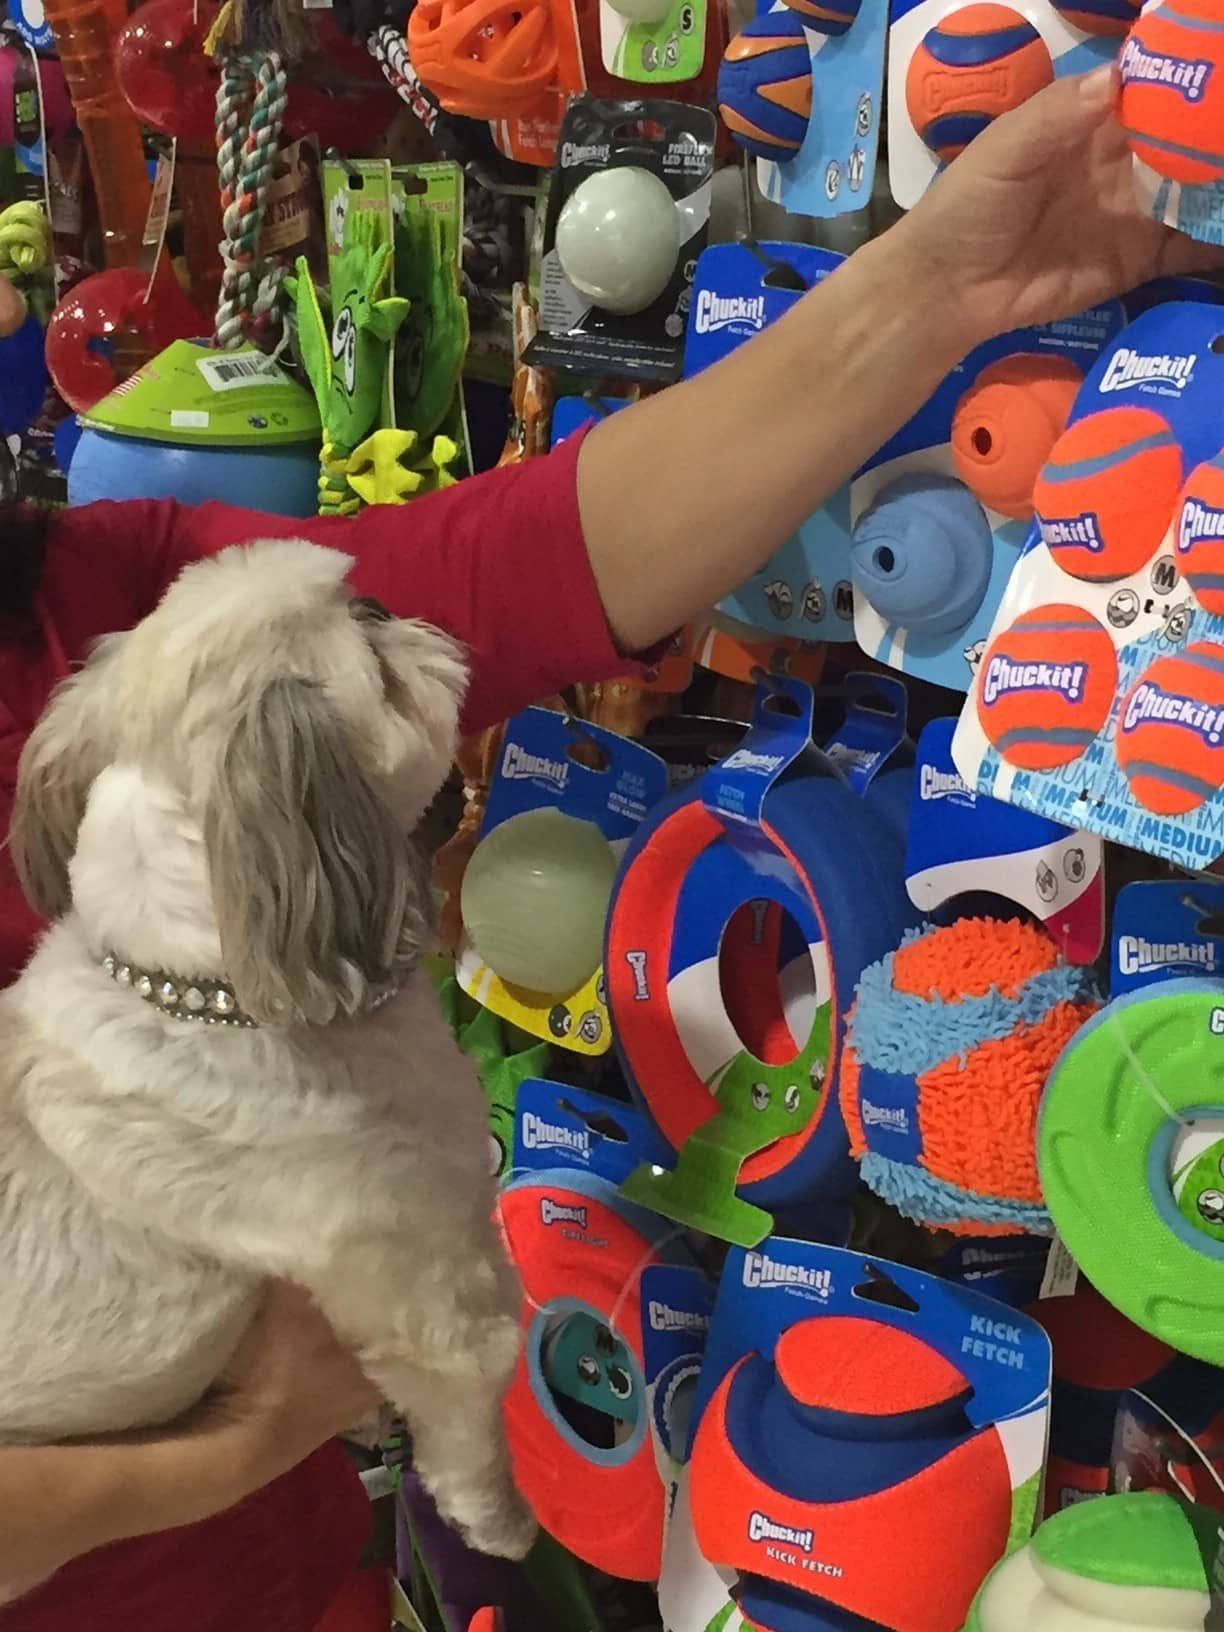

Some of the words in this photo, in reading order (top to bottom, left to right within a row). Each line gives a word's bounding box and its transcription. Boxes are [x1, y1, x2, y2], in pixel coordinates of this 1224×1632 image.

[1119, 40, 1207, 98] Chuckit!
[561, 142, 611, 168] Chuckit!
[684, 155, 707, 168] BALL
[696, 290, 764, 333] Chuckit!
[1099, 348, 1197, 393] Chuckit!
[1155, 562, 1176, 588] M
[984, 657, 1083, 703] Chuckit!
[1124, 684, 1224, 743] Chuckit!
[502, 743, 568, 788] Chuckit!
[722, 748, 784, 772] Chuckit!
[1119, 935, 1215, 975] Chuckit!
[862, 1098, 905, 1128] Chuckit!
[522, 1111, 590, 1159] Chuckit!
[541, 1199, 586, 1227] Chuckit!
[743, 1251, 831, 1298] Chuckit!
[969, 1314, 1022, 1345] KICK
[961, 1336, 1025, 1369] FETCH
[749, 1512, 813, 1551] Chuckit!
[766, 1546, 797, 1566] KICK
[802, 1559, 843, 1578] FETCH
